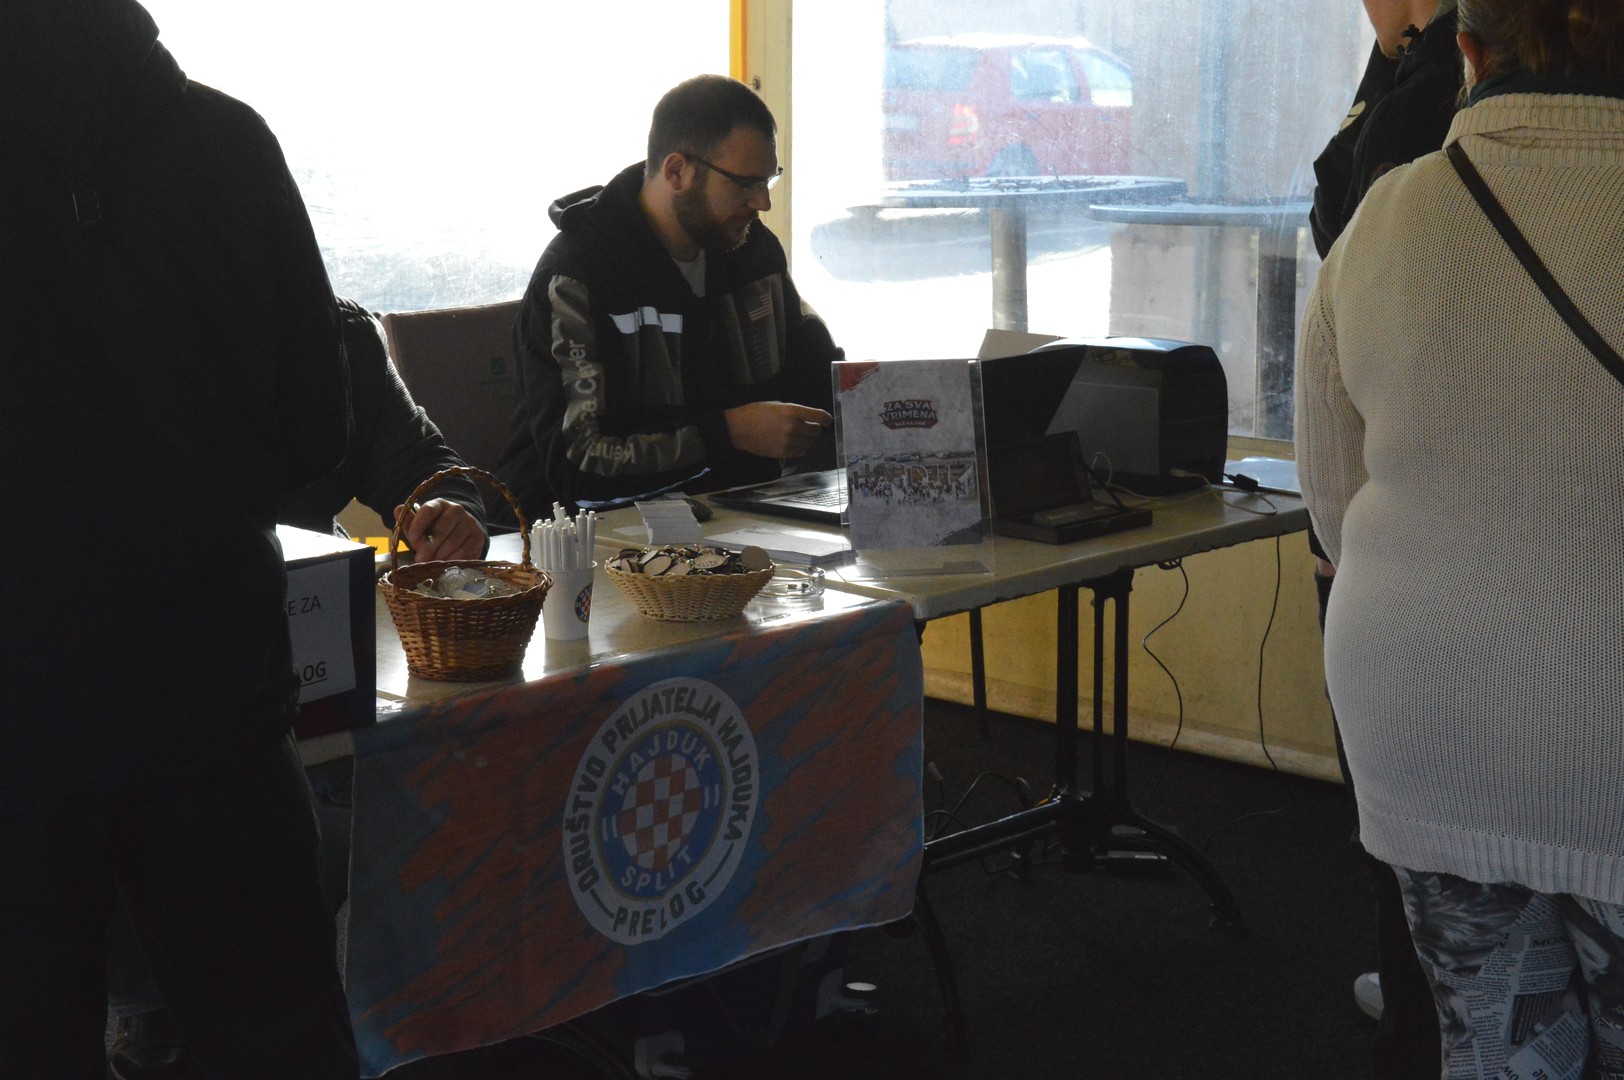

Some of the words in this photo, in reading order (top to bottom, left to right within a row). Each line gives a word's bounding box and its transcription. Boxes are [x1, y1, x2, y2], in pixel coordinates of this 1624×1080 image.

[882, 410, 935, 422] VRIMENA
[887, 402, 902, 411] ZA
[905, 401, 930, 409] SVA
[287, 600, 297, 617] E
[301, 595, 322, 614] ZA
[300, 661, 327, 683] OG
[611, 730, 713, 796] HAJDUK
[564, 755, 606, 893] DRUŠTVO
[602, 687, 722, 754] PRIJATELJA
[717, 716, 753, 841] HAJDUKA
[620, 845, 693, 892] SPLIT
[612, 881, 706, 937] PRELOG
